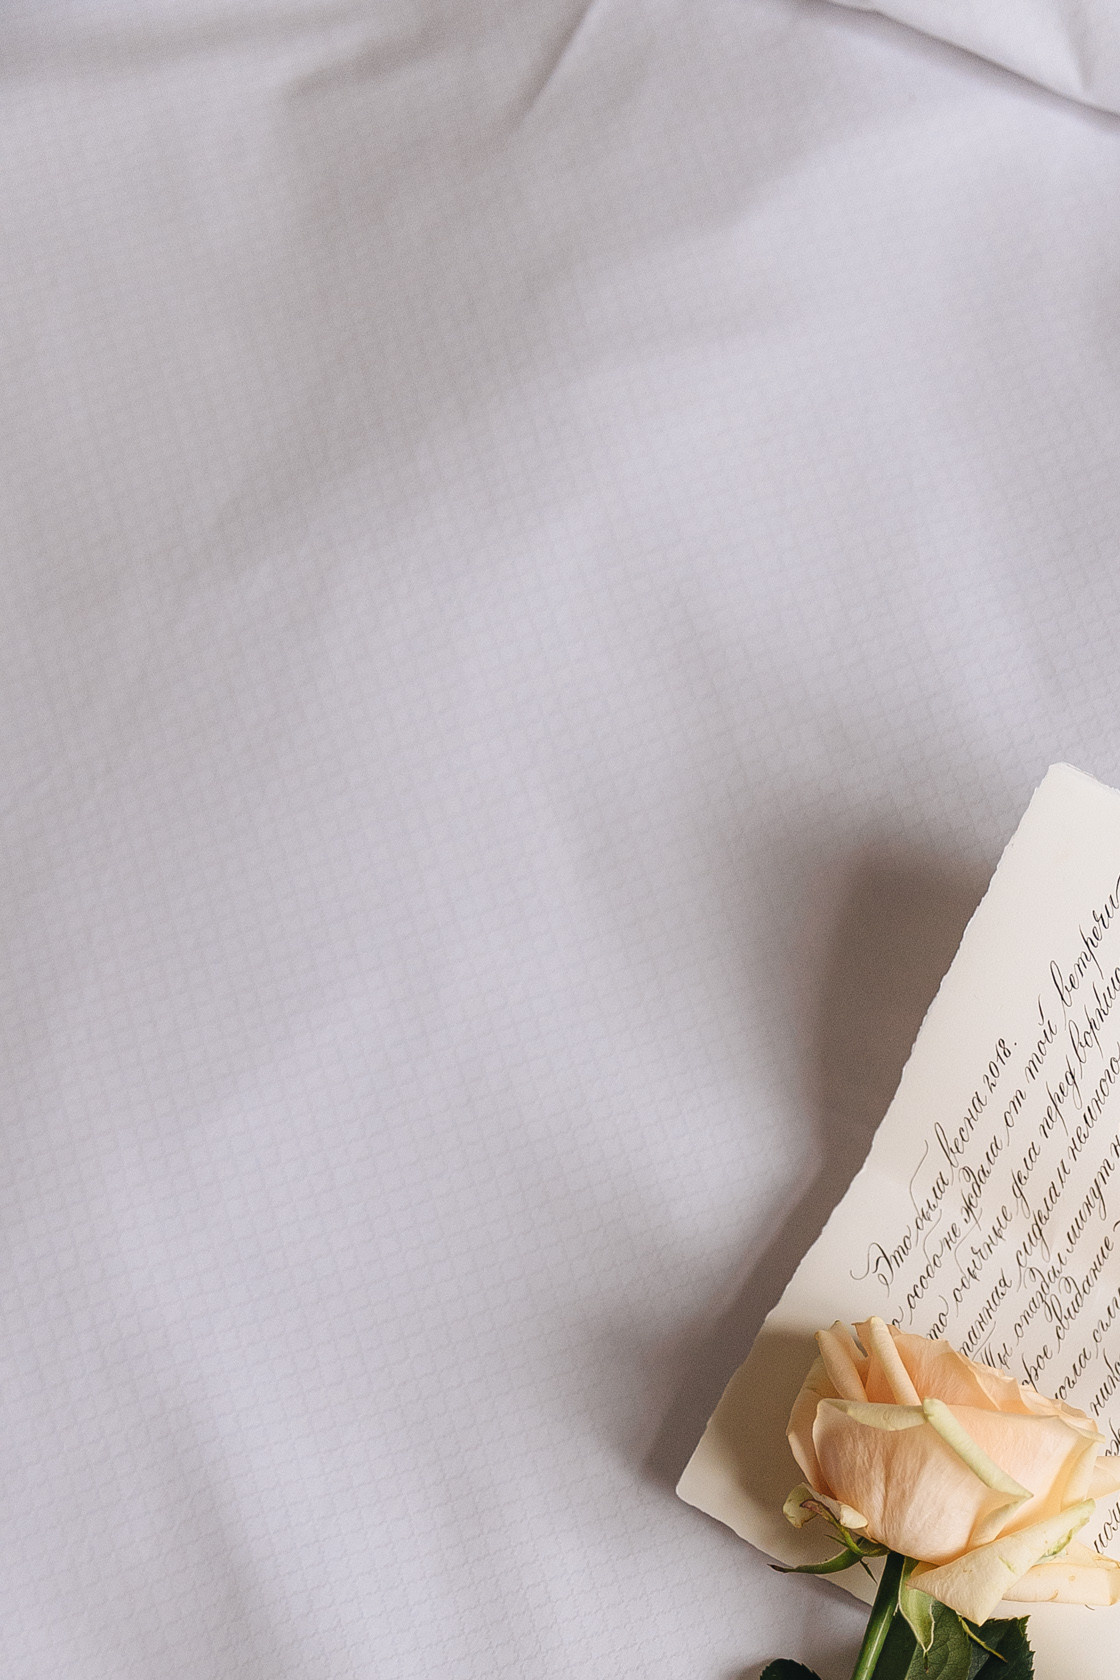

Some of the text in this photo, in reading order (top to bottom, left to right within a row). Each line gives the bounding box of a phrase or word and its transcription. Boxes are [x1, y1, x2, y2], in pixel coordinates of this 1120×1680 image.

[850, 1224, 916, 1298] Это
[914, 1139, 951, 1246] была
[934, 1090, 990, 1186] весна
[983, 1037, 1018, 1093] 2018.
[904, 1208, 945, 1326] особо
[941, 1223, 962, 1252] не
[958, 1135, 1005, 1231] ждала
[1000, 1088, 1029, 1146] от
[1027, 993, 1060, 1083] той
[953, 1204, 1015, 1317] обычные
[1008, 1141, 1043, 1219] дела
[1038, 1055, 1081, 1138] перед
[1013, 1186, 1061, 1292] сидела
[1063, 1158, 1116, 1254] минут
[1050, 1235, 1117, 1354] свидание
